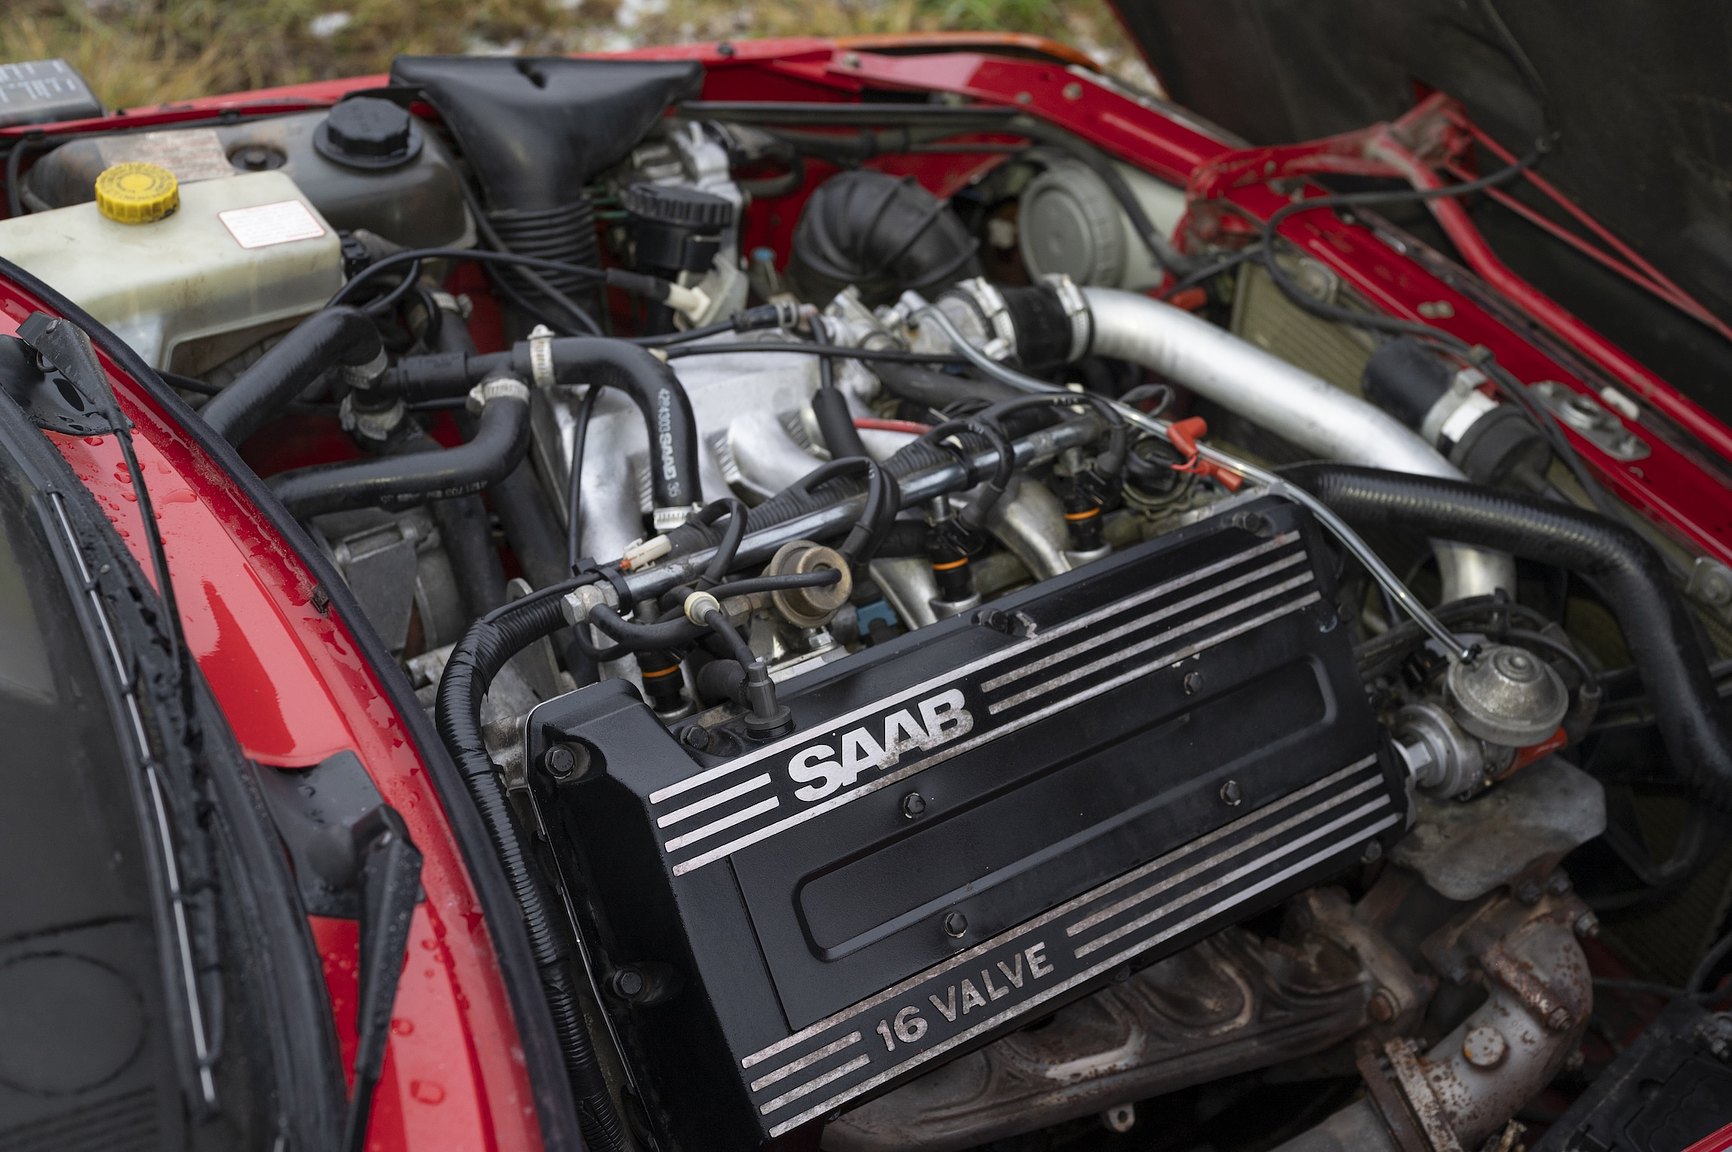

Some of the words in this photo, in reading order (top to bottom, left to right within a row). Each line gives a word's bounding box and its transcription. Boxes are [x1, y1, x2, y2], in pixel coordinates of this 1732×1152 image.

[659, 432, 677, 480] SAAB
[788, 688, 974, 802] SAAB
[876, 1005, 928, 1052] 16
[928, 941, 1055, 1022] VALVE
